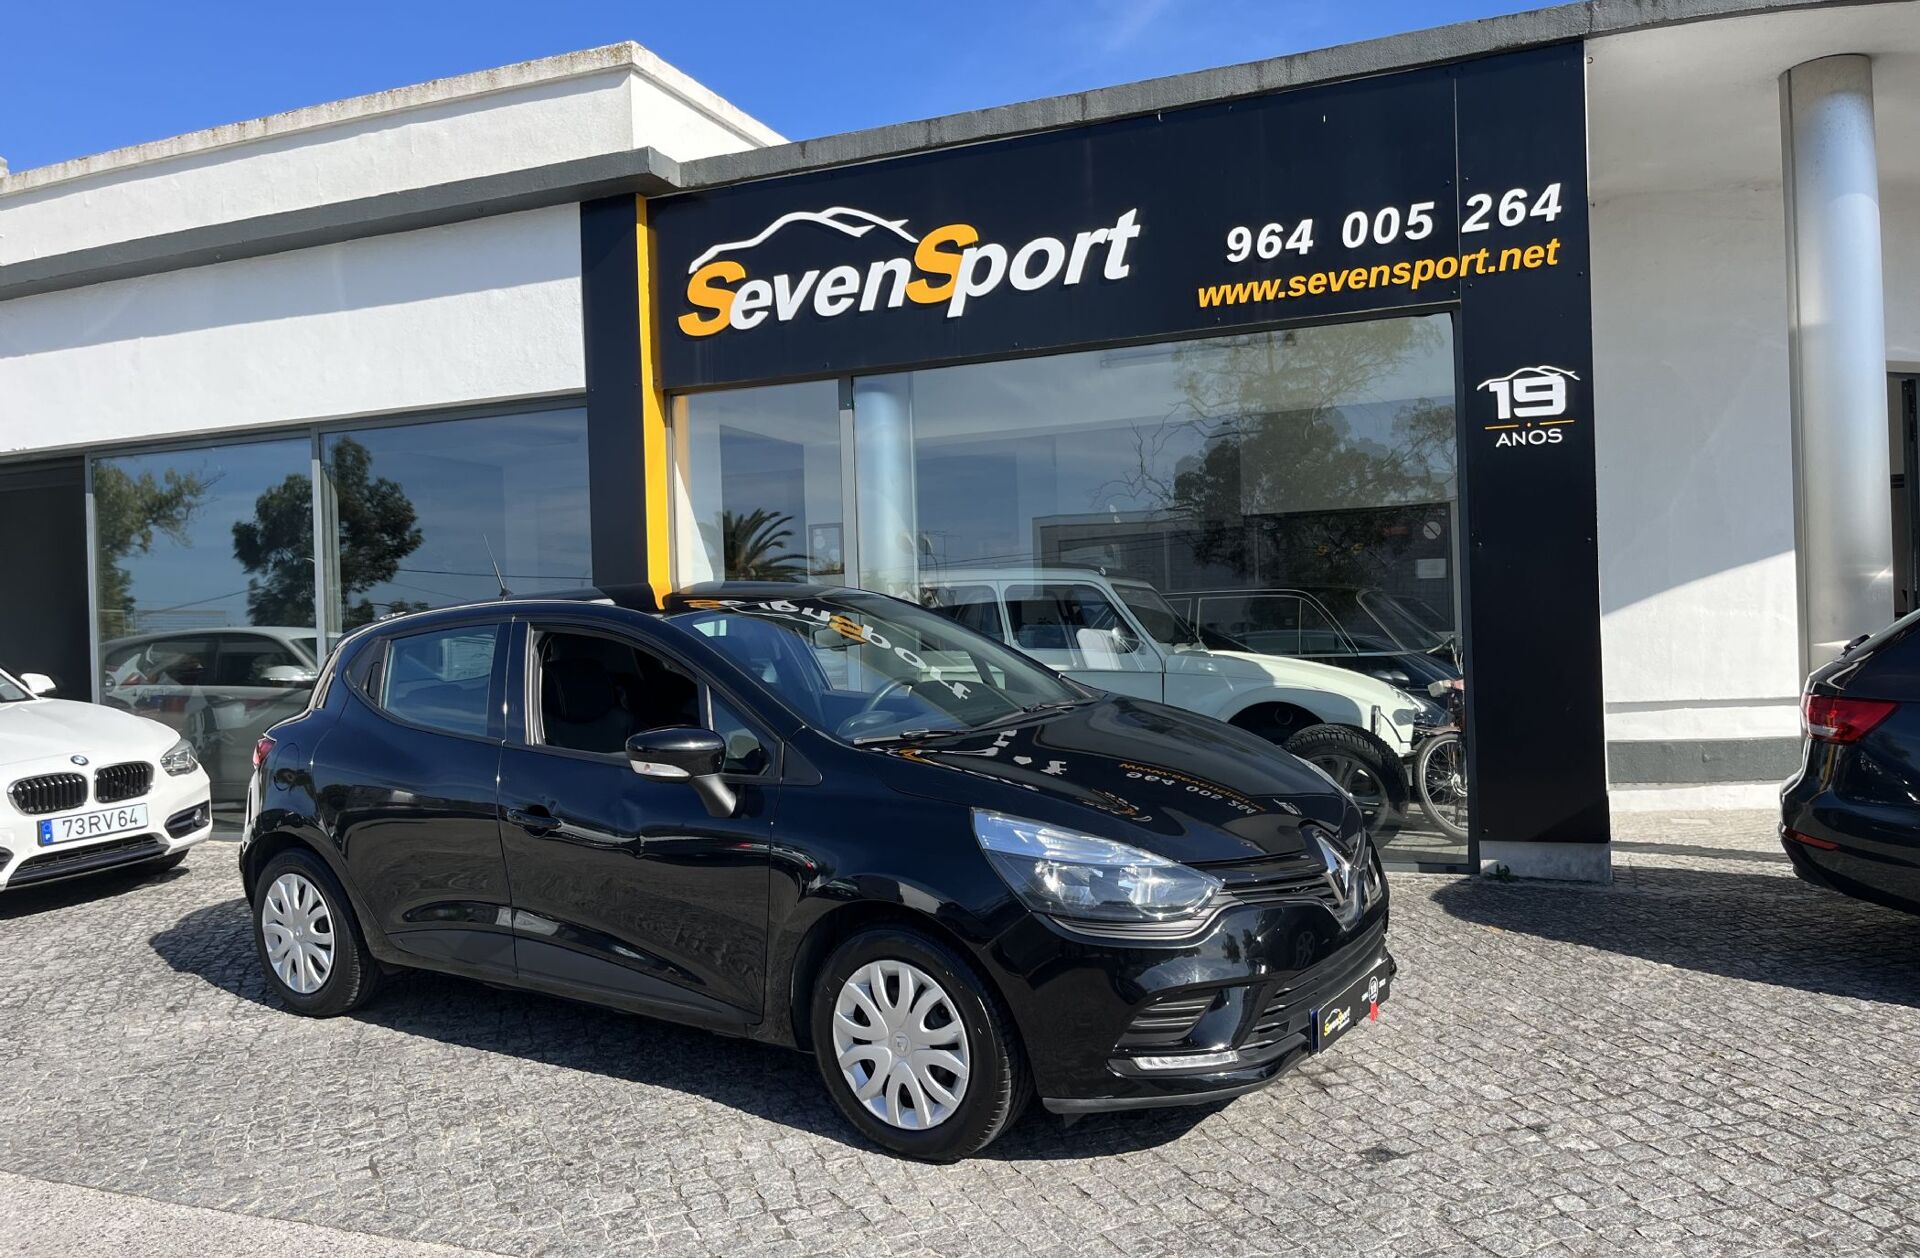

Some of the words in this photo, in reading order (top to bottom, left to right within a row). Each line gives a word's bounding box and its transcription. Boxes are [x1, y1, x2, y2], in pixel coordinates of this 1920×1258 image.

[1226, 219, 1314, 263] 964
[1341, 201, 1436, 249] 005
[1461, 183, 1562, 233] 264
[677, 207, 1141, 337] SevenSport
[1198, 237, 1561, 308] www.sevensport.net
[1488, 374, 1567, 420] 19
[1495, 427, 1563, 448] ANOS
